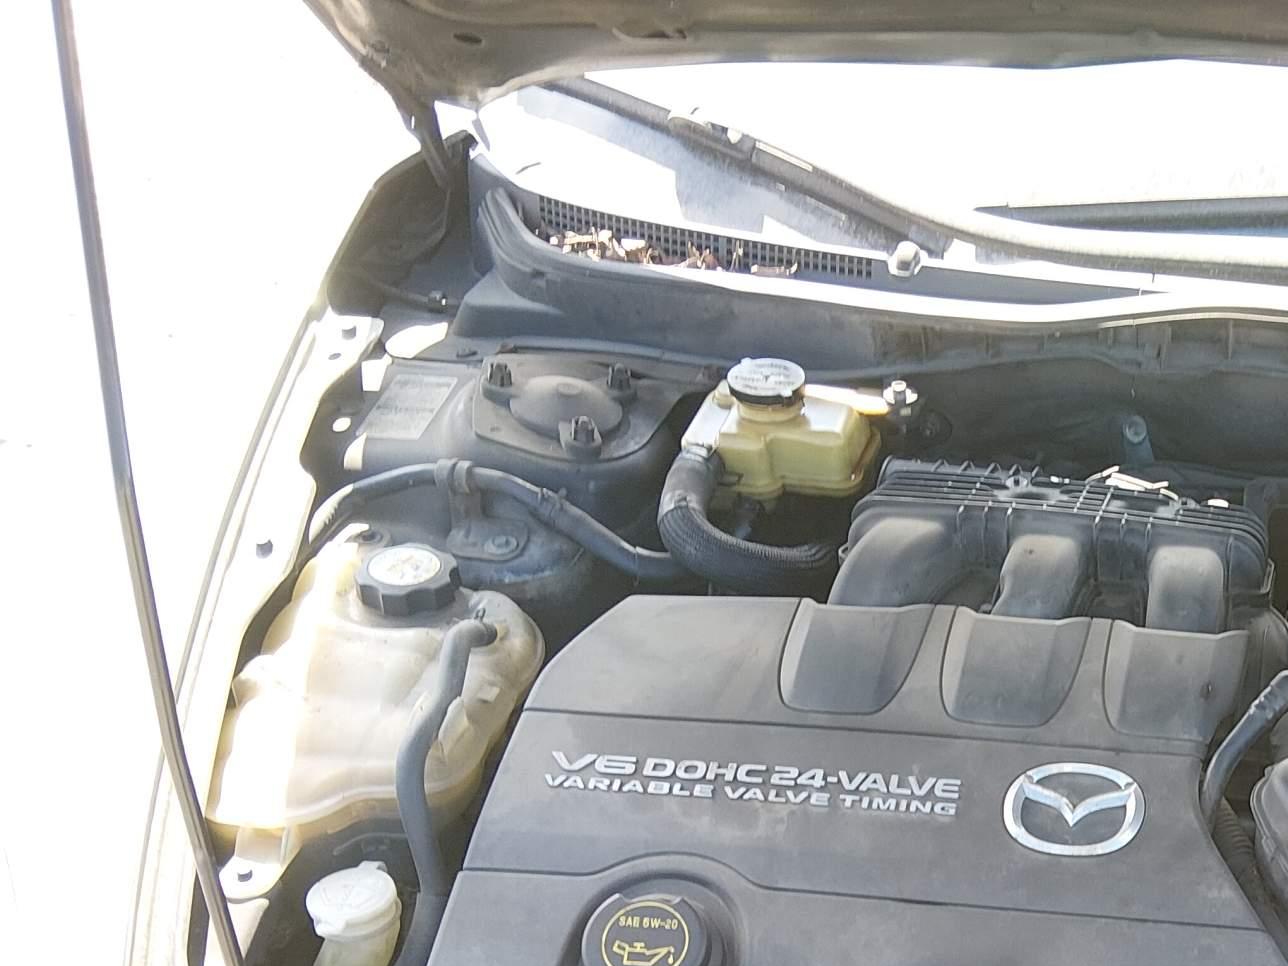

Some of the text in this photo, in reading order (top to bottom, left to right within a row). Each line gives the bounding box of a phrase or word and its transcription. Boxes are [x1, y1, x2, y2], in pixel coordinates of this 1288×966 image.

[544, 773, 958, 816] VARIABLE VALVE TIMING
[551, 751, 962, 799] V6 DOHC 24-VALVE
[618, 915, 640, 929] SAE
